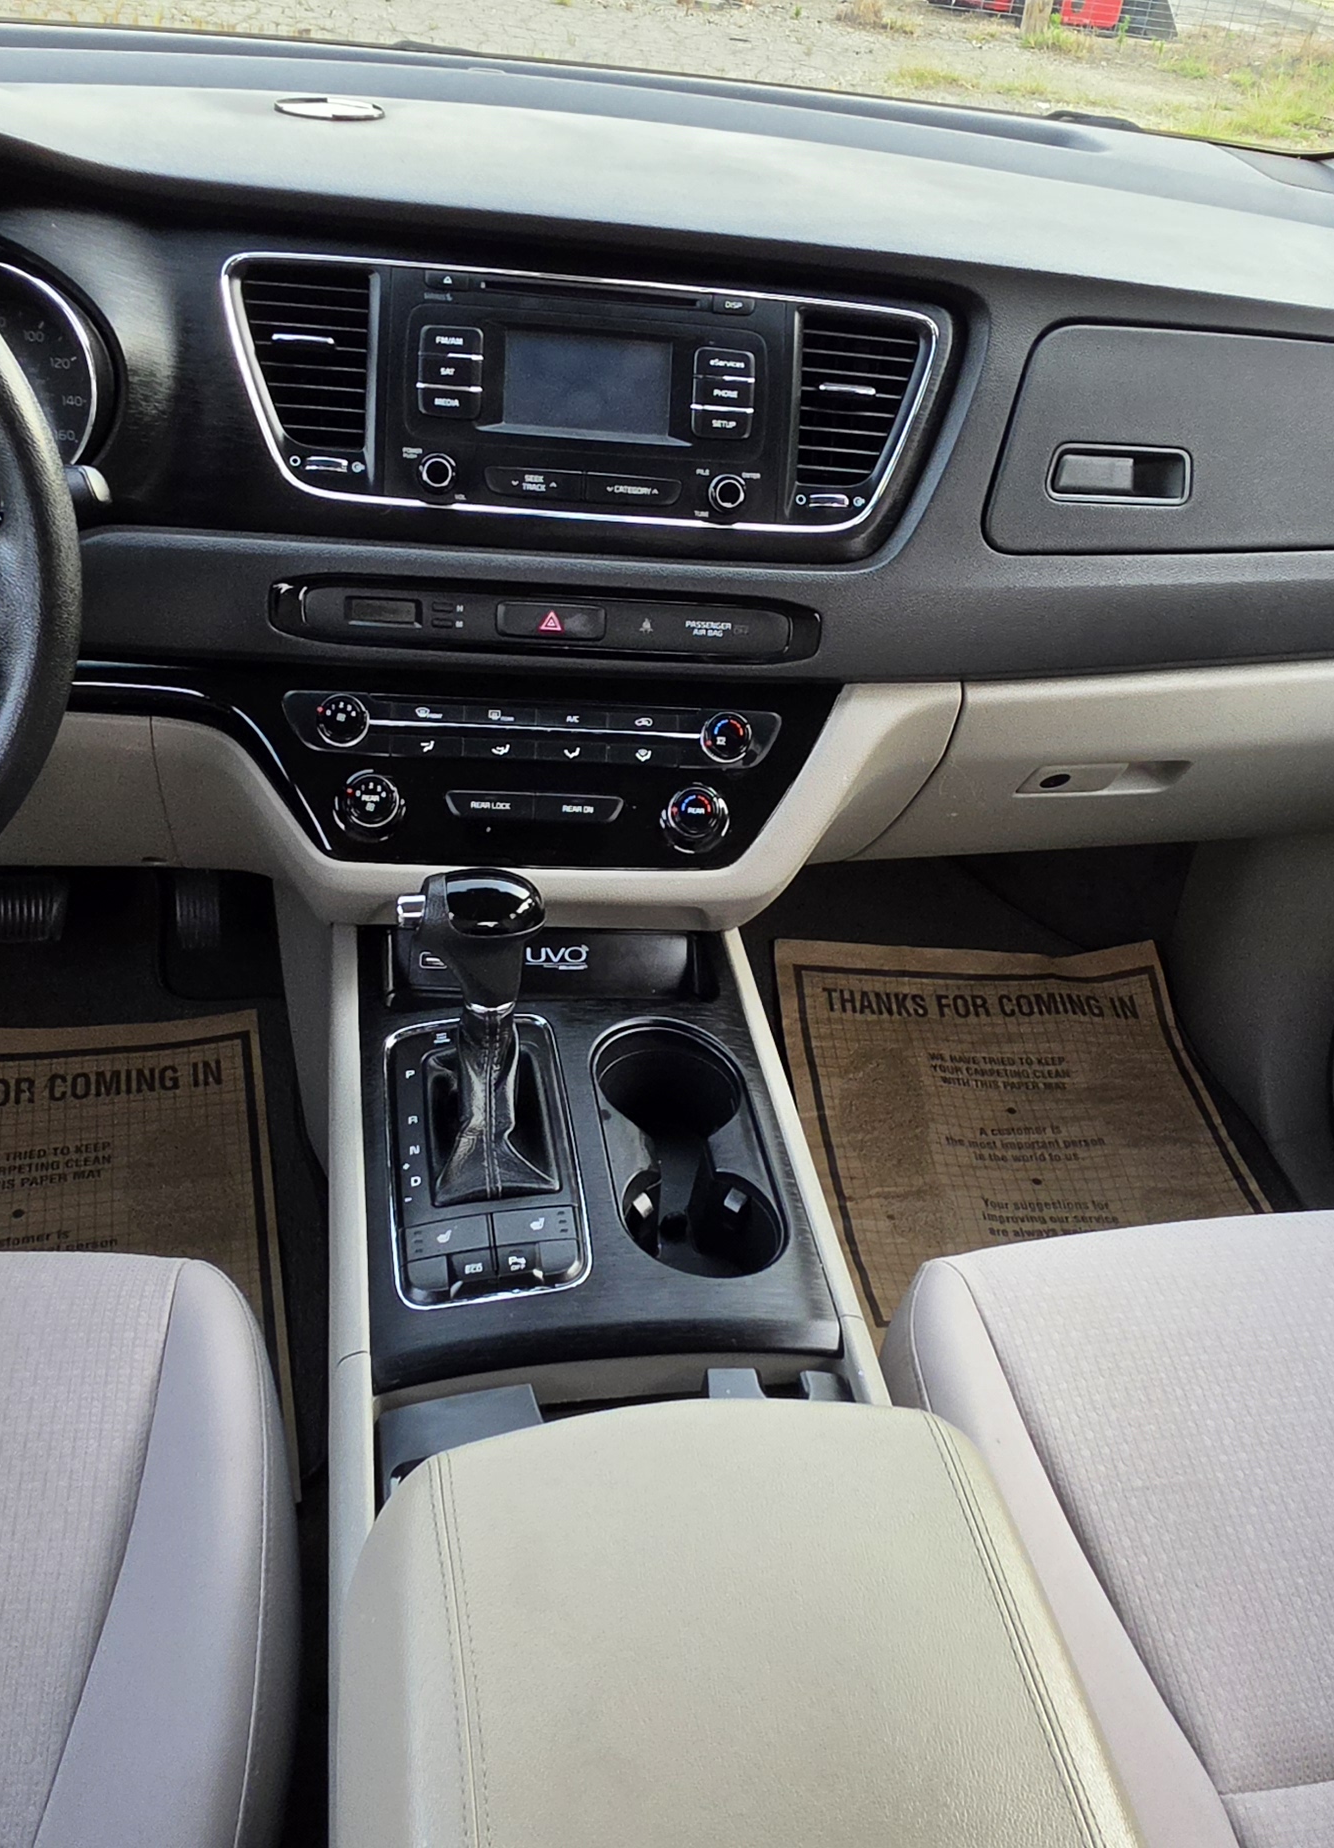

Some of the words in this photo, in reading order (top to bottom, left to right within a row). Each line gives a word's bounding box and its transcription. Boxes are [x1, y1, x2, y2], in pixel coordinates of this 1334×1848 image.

[724, 301, 743, 309] DISP
[23, 330, 45, 343] 100
[435, 336, 464, 346] FM/AM
[50, 357, 71, 370] 120
[440, 367, 456, 376] SAT
[713, 389, 739, 399] PHONE
[62, 395, 82, 407] 140
[434, 398, 460, 408] MEDIA
[711, 419, 737, 429] SETUP
[54, 429, 76, 441] 160
[524, 474, 545, 483] SEEK
[522, 482, 546, 492] TRACK
[614, 485, 652, 495] CATEGORY
[685, 620, 732, 630] PASSENGER
[693, 628, 706, 636] AIR
[707, 629, 724, 638] BAG
[566, 715, 580, 724] A/C
[361, 794, 380, 802] REAR
[470, 801, 490, 809] REAR
[491, 802, 512, 810] LOCK
[562, 805, 582, 813] REAR
[583, 806, 594, 814] ON
[687, 807, 705, 815] REAR
[525, 945, 587, 963] UVO
[822, 987, 929, 1018] THANKS
[934, 994, 990, 1019] FOR
[998, 992, 1105, 1018] COMING
[1109, 995, 1140, 1020] IN
[928, 1052, 948, 1062] WE
[950, 1054, 980, 1065] HAVE
[982, 1056, 1016, 1066] TRIED
[1018, 1056, 1033, 1066] TO
[1036, 1056, 1066, 1067] KEEP
[405, 1069, 416, 1079] P
[930, 1063, 964, 1075] YOUR
[967, 1067, 1031, 1079] CARPETING
[1032, 1069, 1071, 1079] CLEAN
[48, 1064, 181, 1102] COMING
[191, 1058, 223, 1088] IN
[940, 1076, 971, 1087] WITH
[974, 1079, 1000, 1090] THIS
[1002, 1081, 1039, 1091] PAPER
[408, 1115, 418, 1125] R
[979, 1127, 988, 1137] A
[991, 1125, 1047, 1137] customer
[1050, 1123, 1063, 1135] is
[945, 1135, 965, 1147] the
[968, 1139, 998, 1151] most
[1000, 1139, 1060, 1151] important
[1062, 1136, 1105, 1149] person
[5, 1148, 47, 1162] TRIED
[52, 1145, 71, 1157] TO
[74, 1141, 111, 1154] KEEP
[409, 1145, 420, 1155] N
[64, 1154, 112, 1169] CLEAN
[988, 1151, 1008, 1163] the
[1012, 1151, 1047, 1163] world
[1049, 1151, 1062, 1162] to
[20, 1173, 68, 1188] PAPER
[73, 1168, 104, 1181] MAT
[410, 1176, 422, 1187] D
[981, 1196, 1009, 1210] Your
[1012, 1199, 1089, 1213] suggestions
[1092, 1200, 1109, 1211] for
[982, 1211, 1047, 1226] improving
[1049, 1214, 1071, 1224] our
[1072, 1213, 1119, 1225] service
[58, 1229, 72, 1240] is
[987, 1227, 1008, 1238] are
[1012, 1226, 1058, 1238] always
[465, 1262, 483, 1275] ECO
